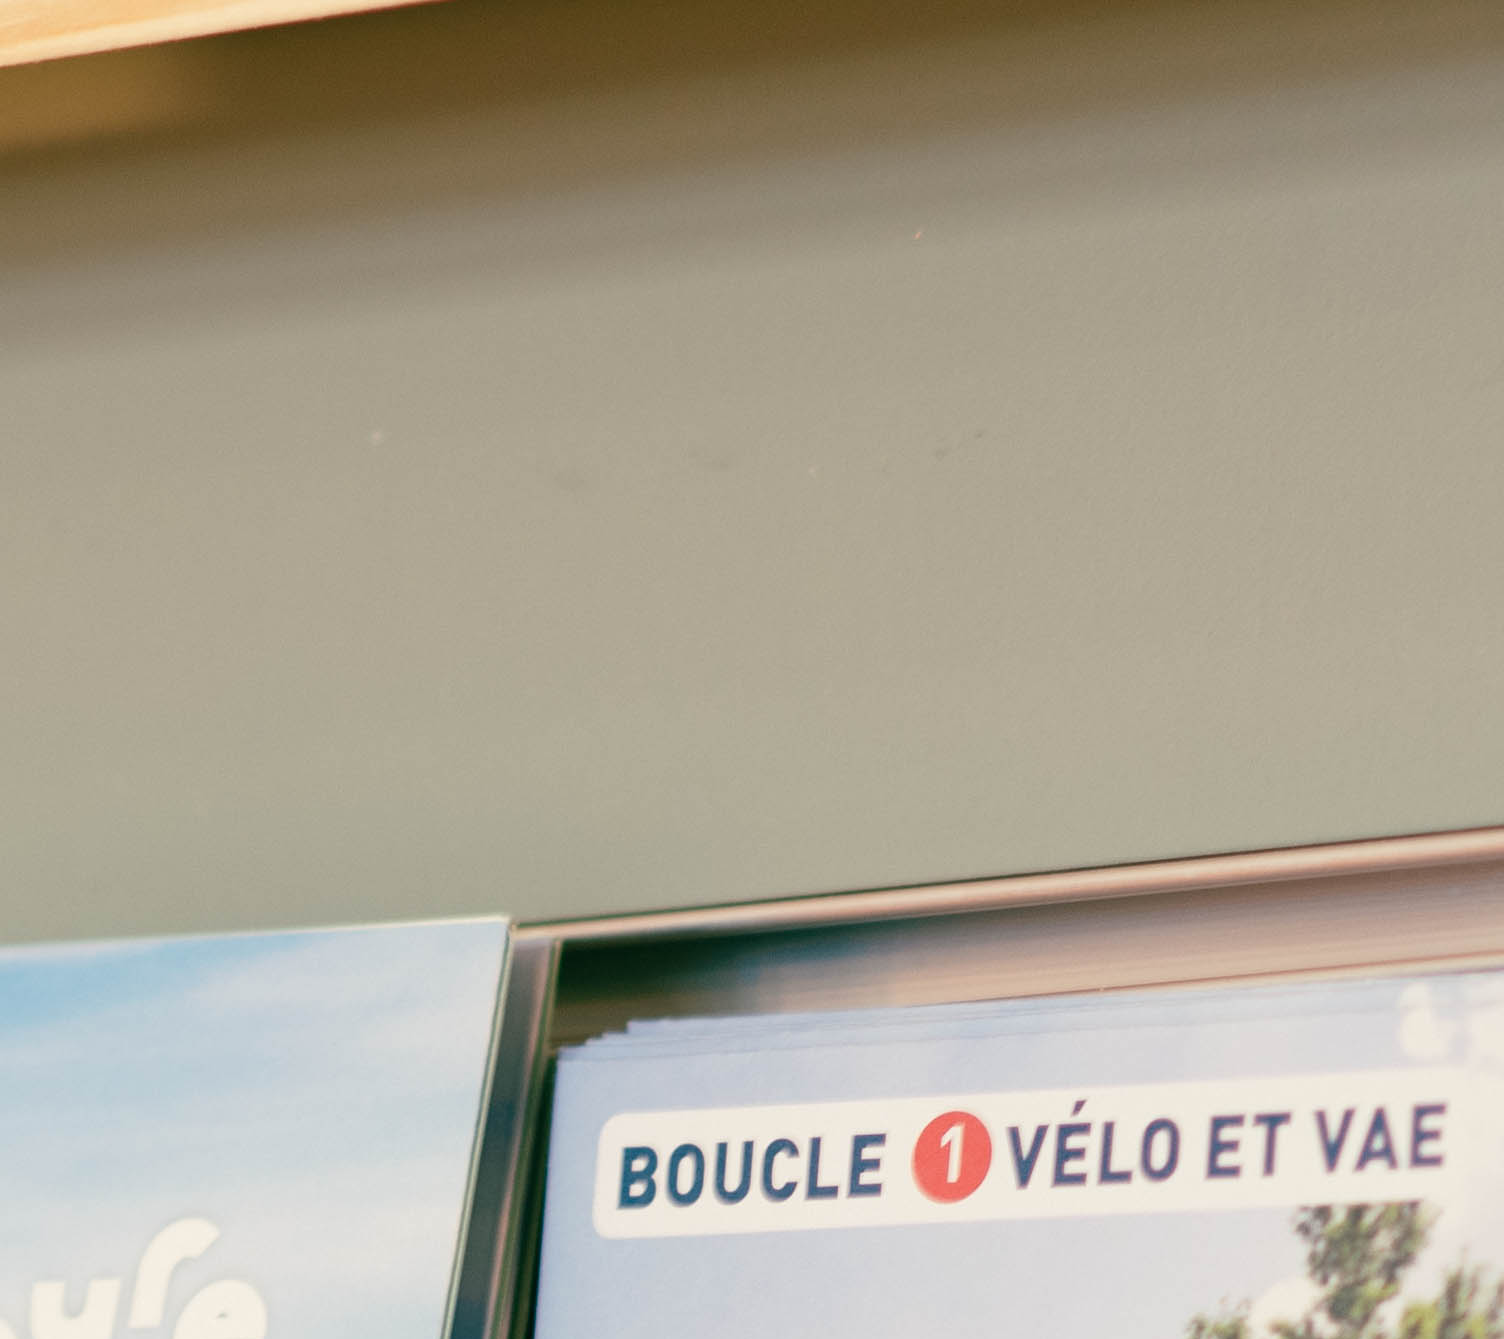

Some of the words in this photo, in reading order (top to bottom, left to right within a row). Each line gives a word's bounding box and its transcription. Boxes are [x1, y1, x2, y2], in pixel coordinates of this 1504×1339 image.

[616, 1133, 886, 1209] BOUCLE
[937, 1122, 968, 1184] 1
[1005, 1099, 1180, 1188] VÉLO
[1204, 1112, 1290, 1179] ET
[1314, 1102, 1449, 1170] VAE
